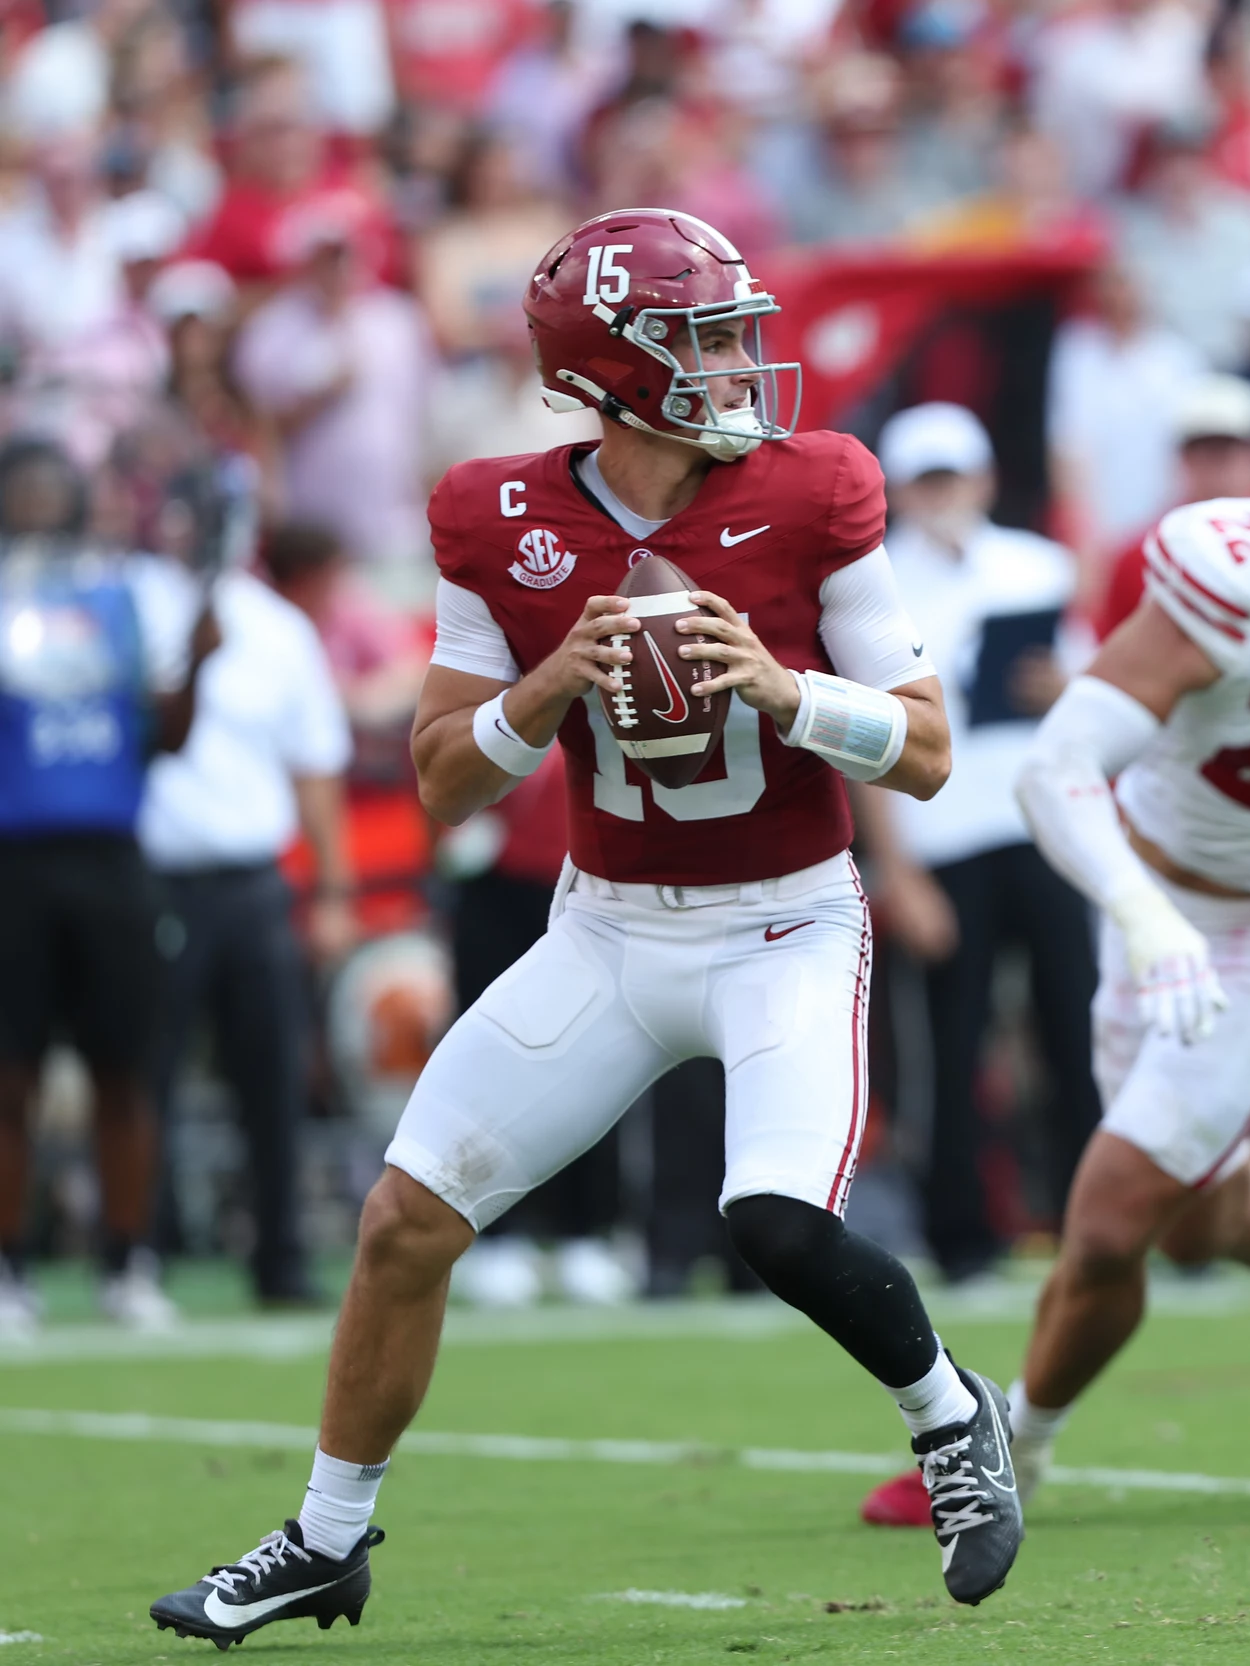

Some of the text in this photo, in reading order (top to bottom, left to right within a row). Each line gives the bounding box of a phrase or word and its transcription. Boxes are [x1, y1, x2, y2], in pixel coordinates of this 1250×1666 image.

[583, 244, 634, 306] 15
[500, 480, 527, 517] C
[518, 529, 561, 573] SEC
[519, 564, 570, 588] GRADUATE
